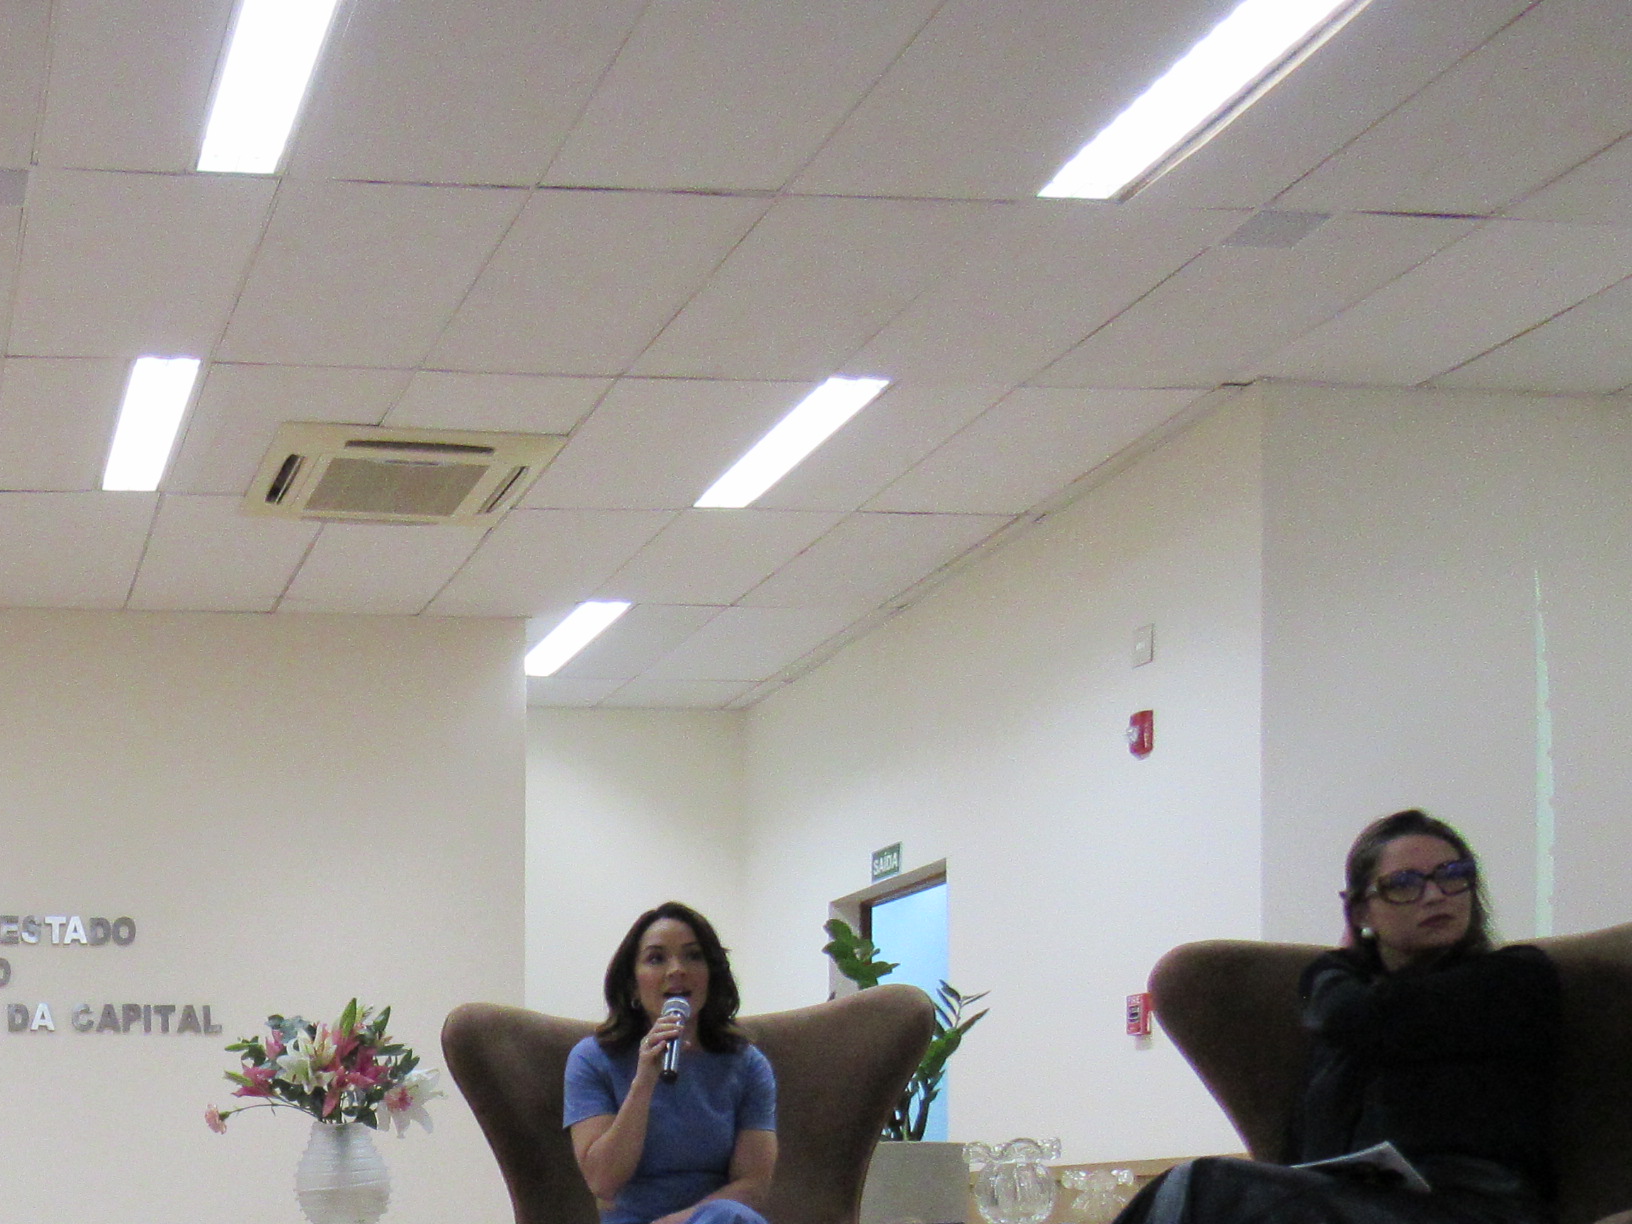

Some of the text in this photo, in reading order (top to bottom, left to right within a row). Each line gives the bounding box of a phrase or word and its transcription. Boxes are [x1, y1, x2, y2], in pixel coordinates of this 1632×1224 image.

[873, 851, 898, 875] SAÍDA
[7, 1002, 56, 1032] DA
[71, 1003, 223, 1034] CAPITAL
